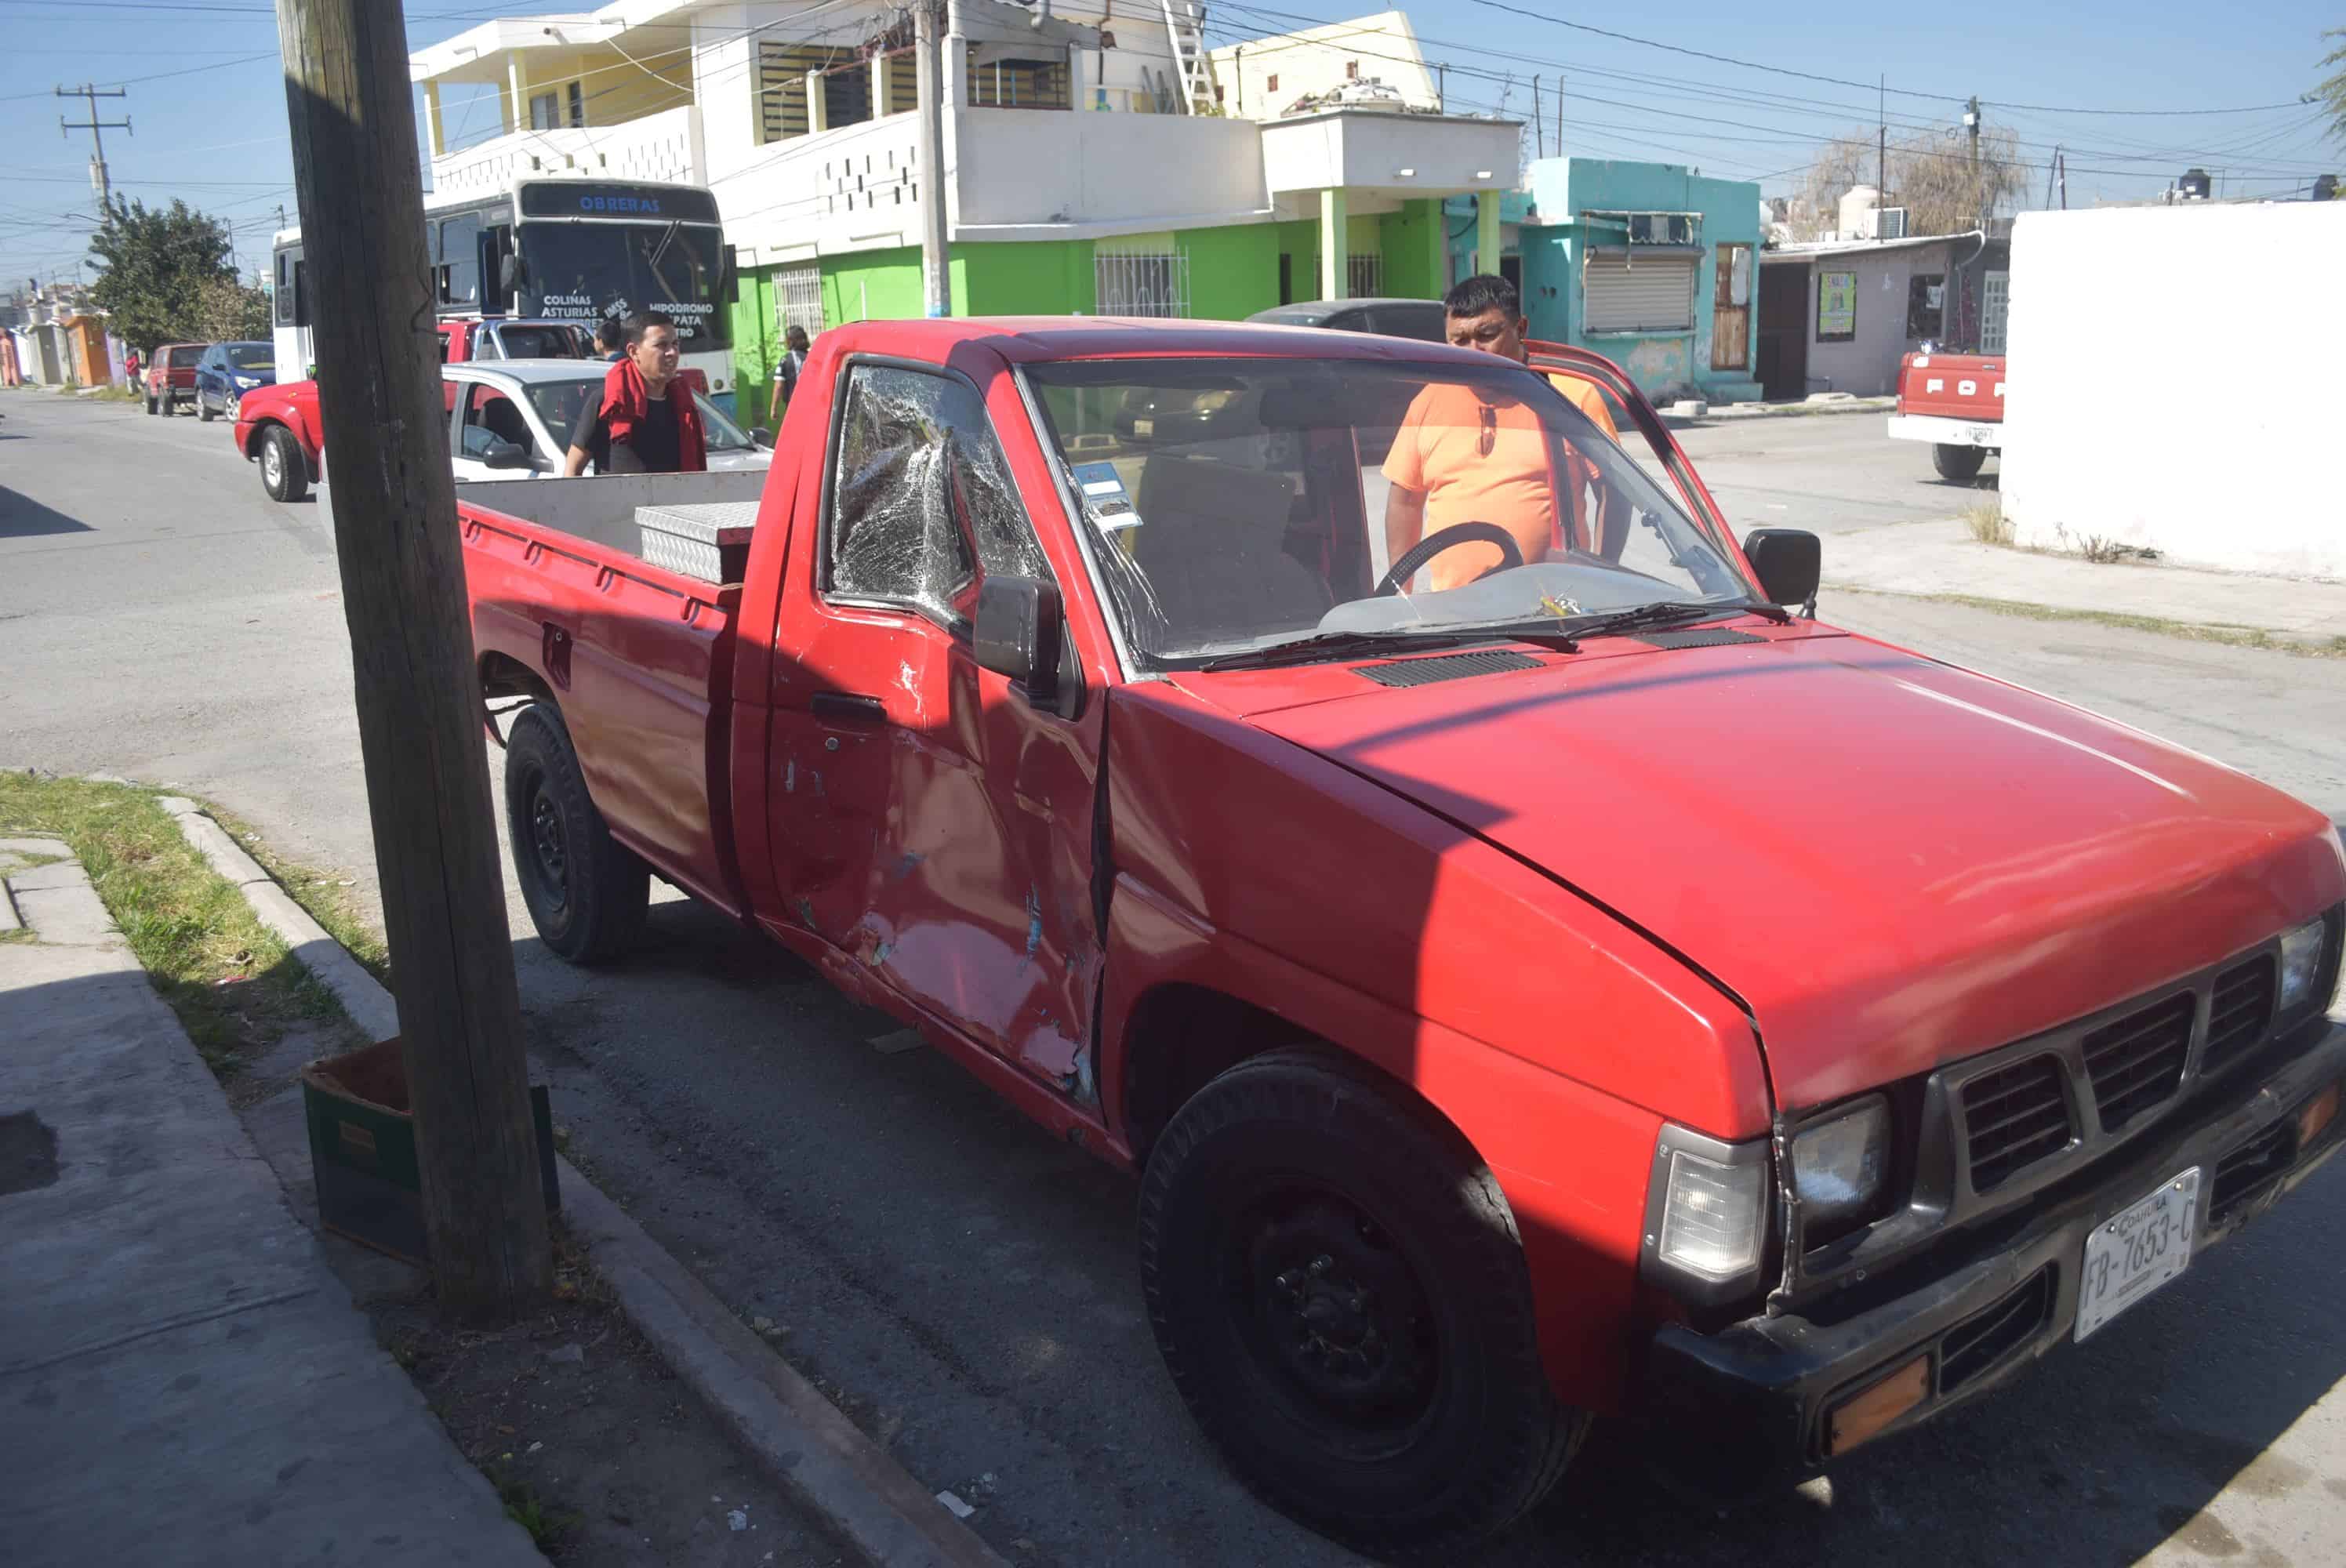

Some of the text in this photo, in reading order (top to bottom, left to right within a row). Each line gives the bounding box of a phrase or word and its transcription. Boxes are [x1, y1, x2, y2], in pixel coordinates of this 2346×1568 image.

[579, 196, 660, 213] OBRERAS
[543, 295, 591, 306] COLINAS
[541, 307, 598, 318] ASTURIAS
[648, 303, 714, 314] HIPODROMO
[672, 314, 703, 326] PATA
[676, 327, 695, 338] TRO
[1926, 378, 2006, 397] FOR
[2083, 1199, 2194, 1308] FB-7653-C
